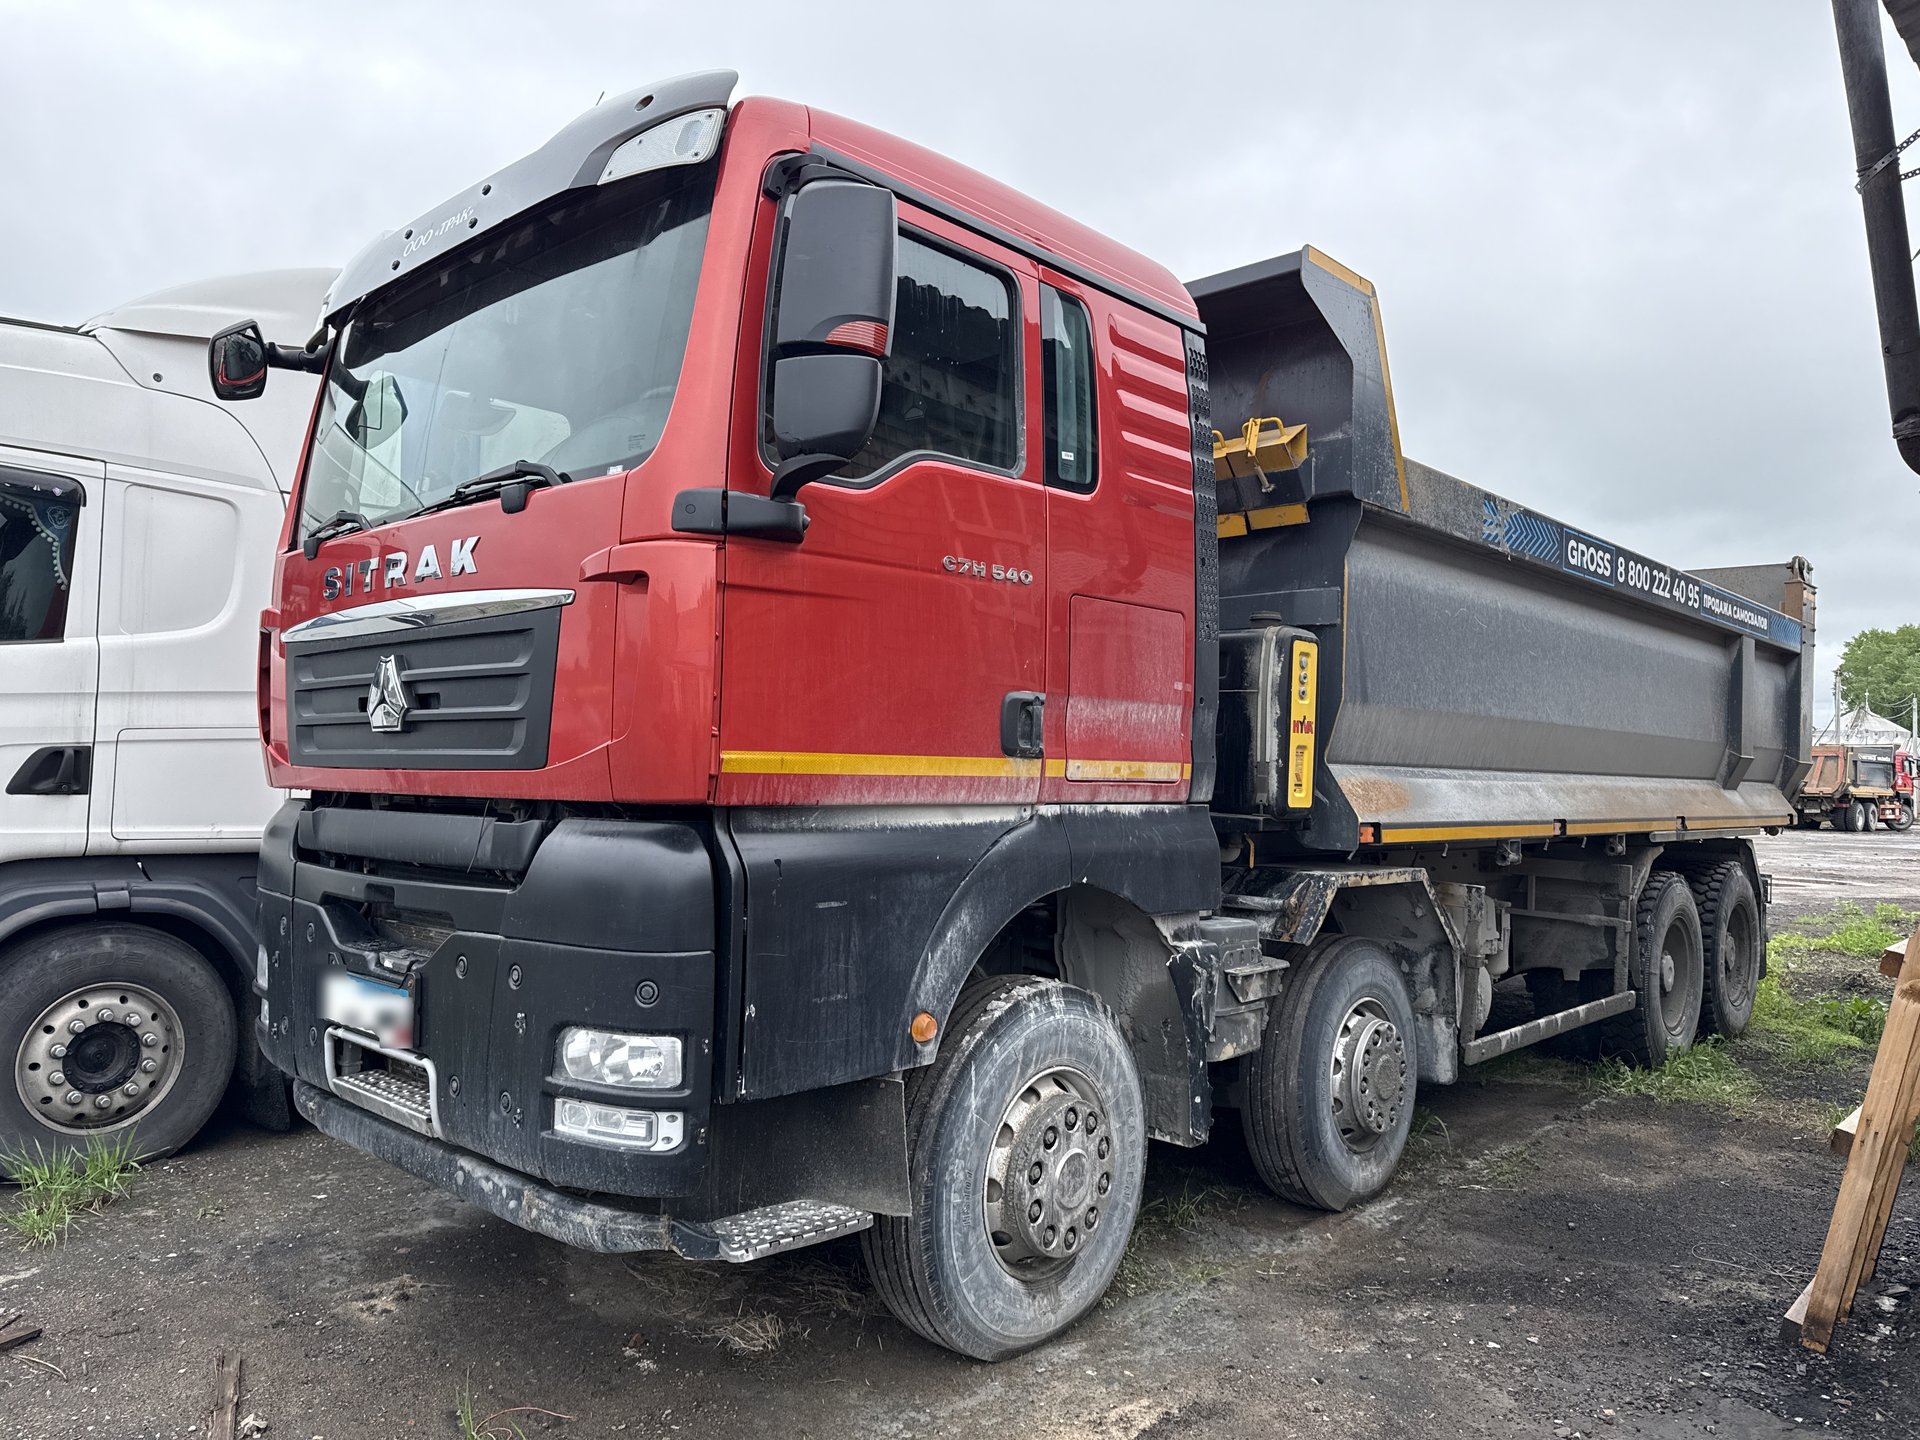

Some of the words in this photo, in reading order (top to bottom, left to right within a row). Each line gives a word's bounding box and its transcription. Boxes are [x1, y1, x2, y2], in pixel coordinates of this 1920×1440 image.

[403, 229, 433, 257] ООО
[323, 536, 481, 600] SITRAK
[943, 555, 986, 578] C7H
[992, 564, 1033, 585] 540
[1567, 539, 1611, 577] GROSS
[1617, 556, 1625, 583] 8
[1628, 560, 1650, 591] 800
[1652, 569, 1670, 599] 222
[1673, 578, 1686, 604] 40
[1688, 583, 1700, 609] 95
[1703, 593, 1732, 617] ПРОДАЖА
[1732, 605, 1768, 630] САМОСВАЛОВ
[1292, 715, 1314, 734] HYVA
